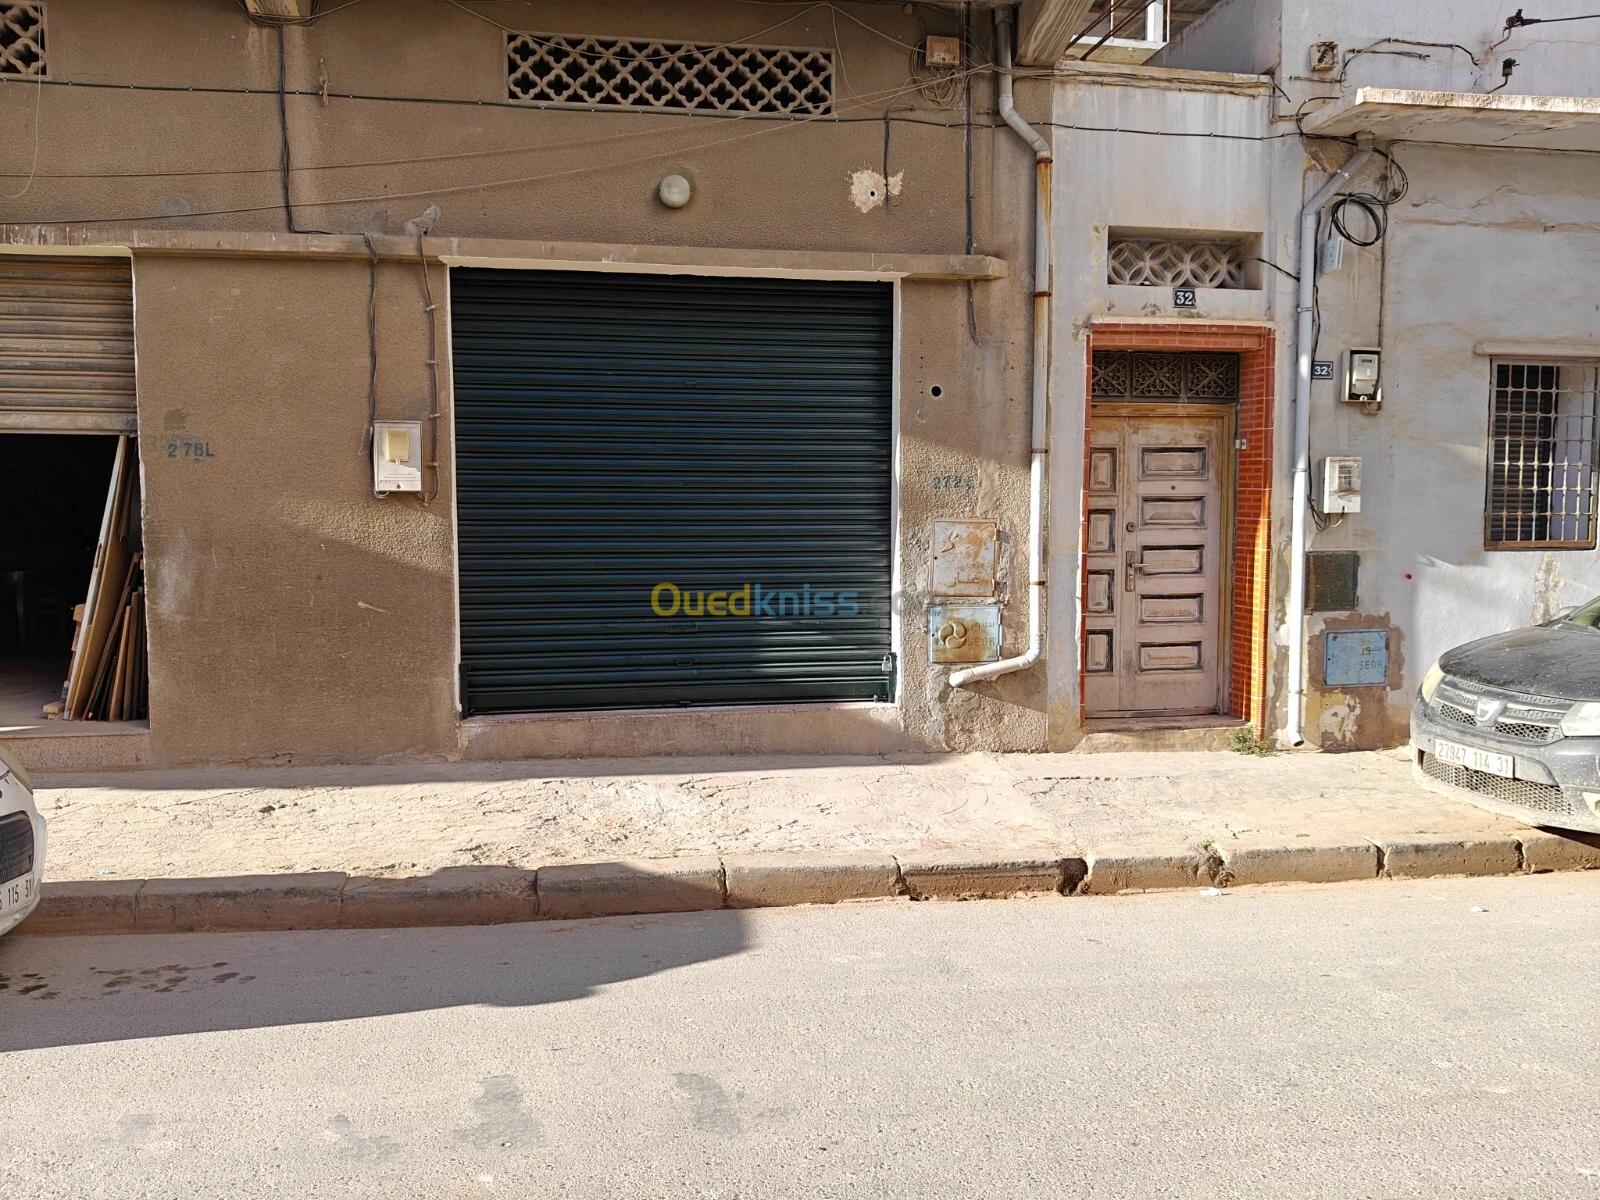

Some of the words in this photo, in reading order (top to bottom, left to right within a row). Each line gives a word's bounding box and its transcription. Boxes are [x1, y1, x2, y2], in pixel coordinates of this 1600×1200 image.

[1176, 291, 1193, 305] 32
[1314, 366, 1328, 375] 32
[1438, 742, 1467, 764] 27947
[1473, 751, 1490, 769] 114
[1497, 757, 1509, 774] 31
[25, 878, 32, 898] 31
